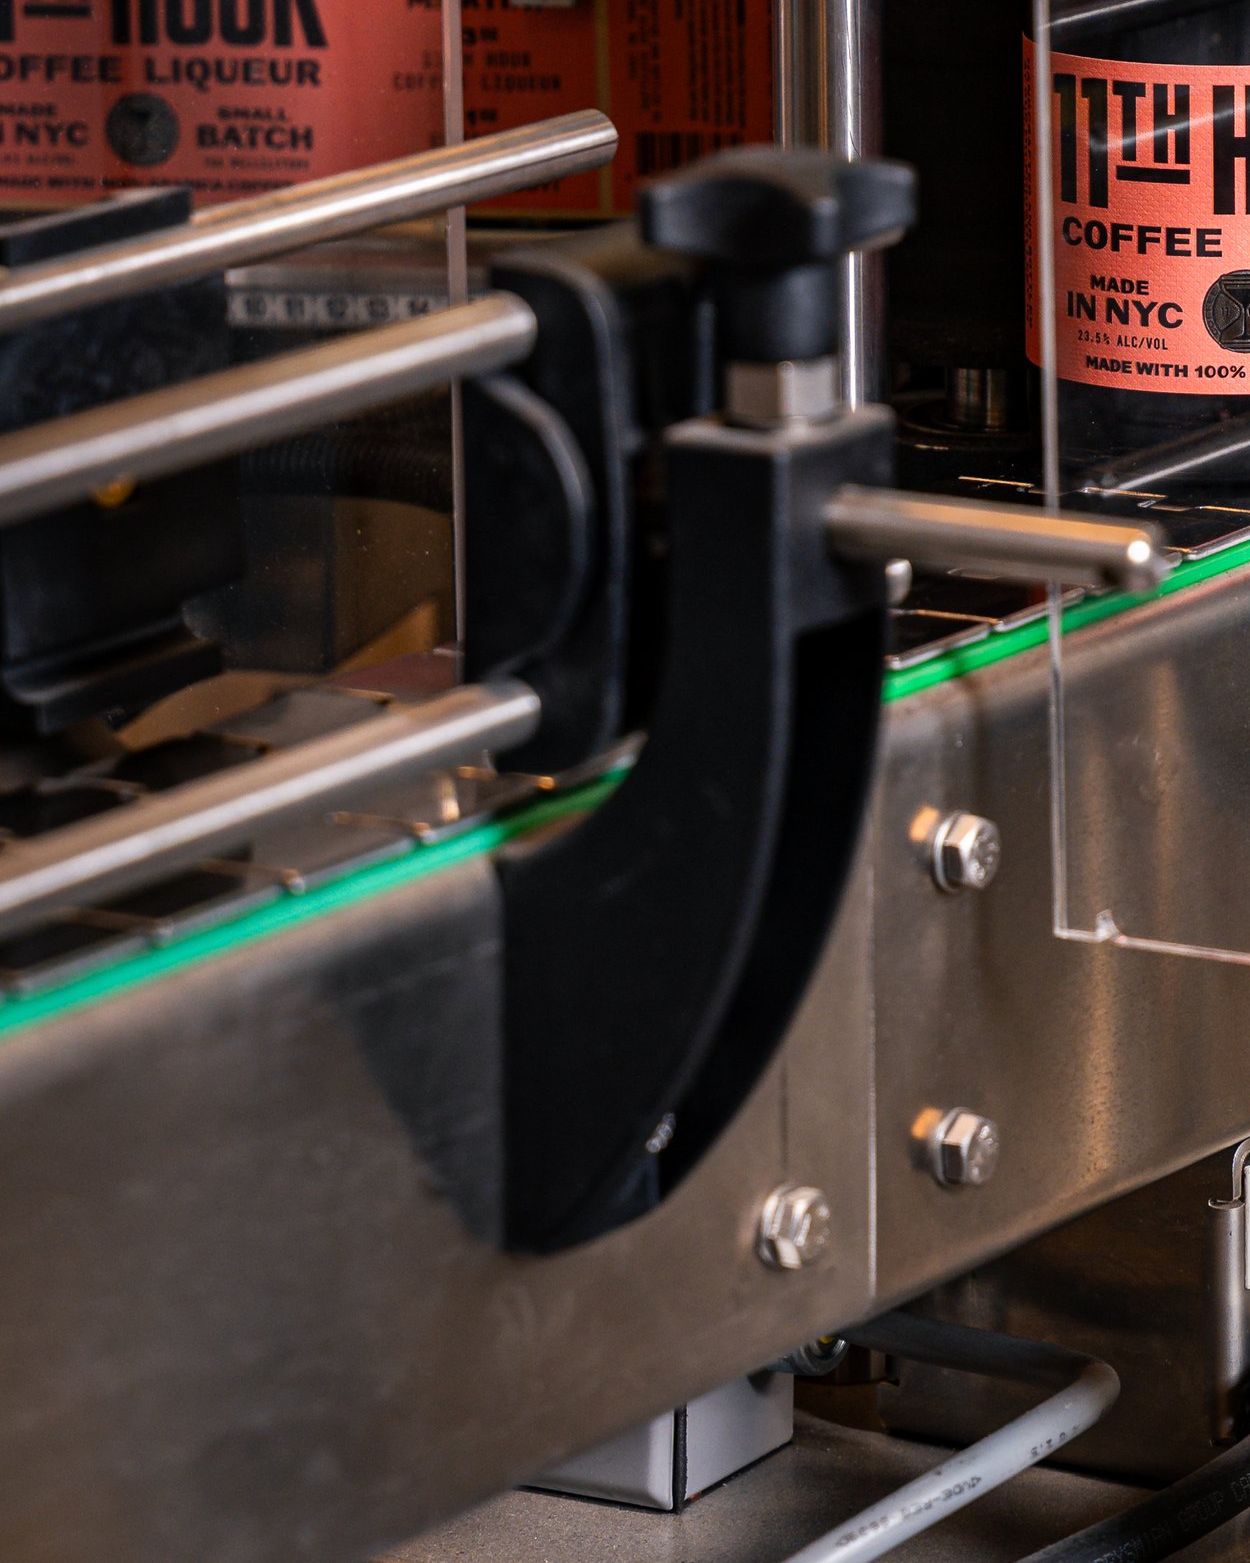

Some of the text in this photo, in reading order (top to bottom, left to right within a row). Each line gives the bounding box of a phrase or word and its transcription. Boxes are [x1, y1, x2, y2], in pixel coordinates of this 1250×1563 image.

[144, 55, 322, 93] LIQUEUR
[15, 121, 90, 147] NYC
[197, 123, 314, 150] BATCH
[1054, 73, 1190, 209] 11TH
[1062, 216, 1223, 258] COFFEE
[1090, 274, 1150, 296] MADE
[1067, 290, 1184, 329] IN NYC
[1077, 329, 1169, 351] 23.5% ALC/VOL
[1085, 355, 1133, 374] MADE
[1135, 361, 1189, 378] WITH
[1194, 365, 1246, 379] 100%
